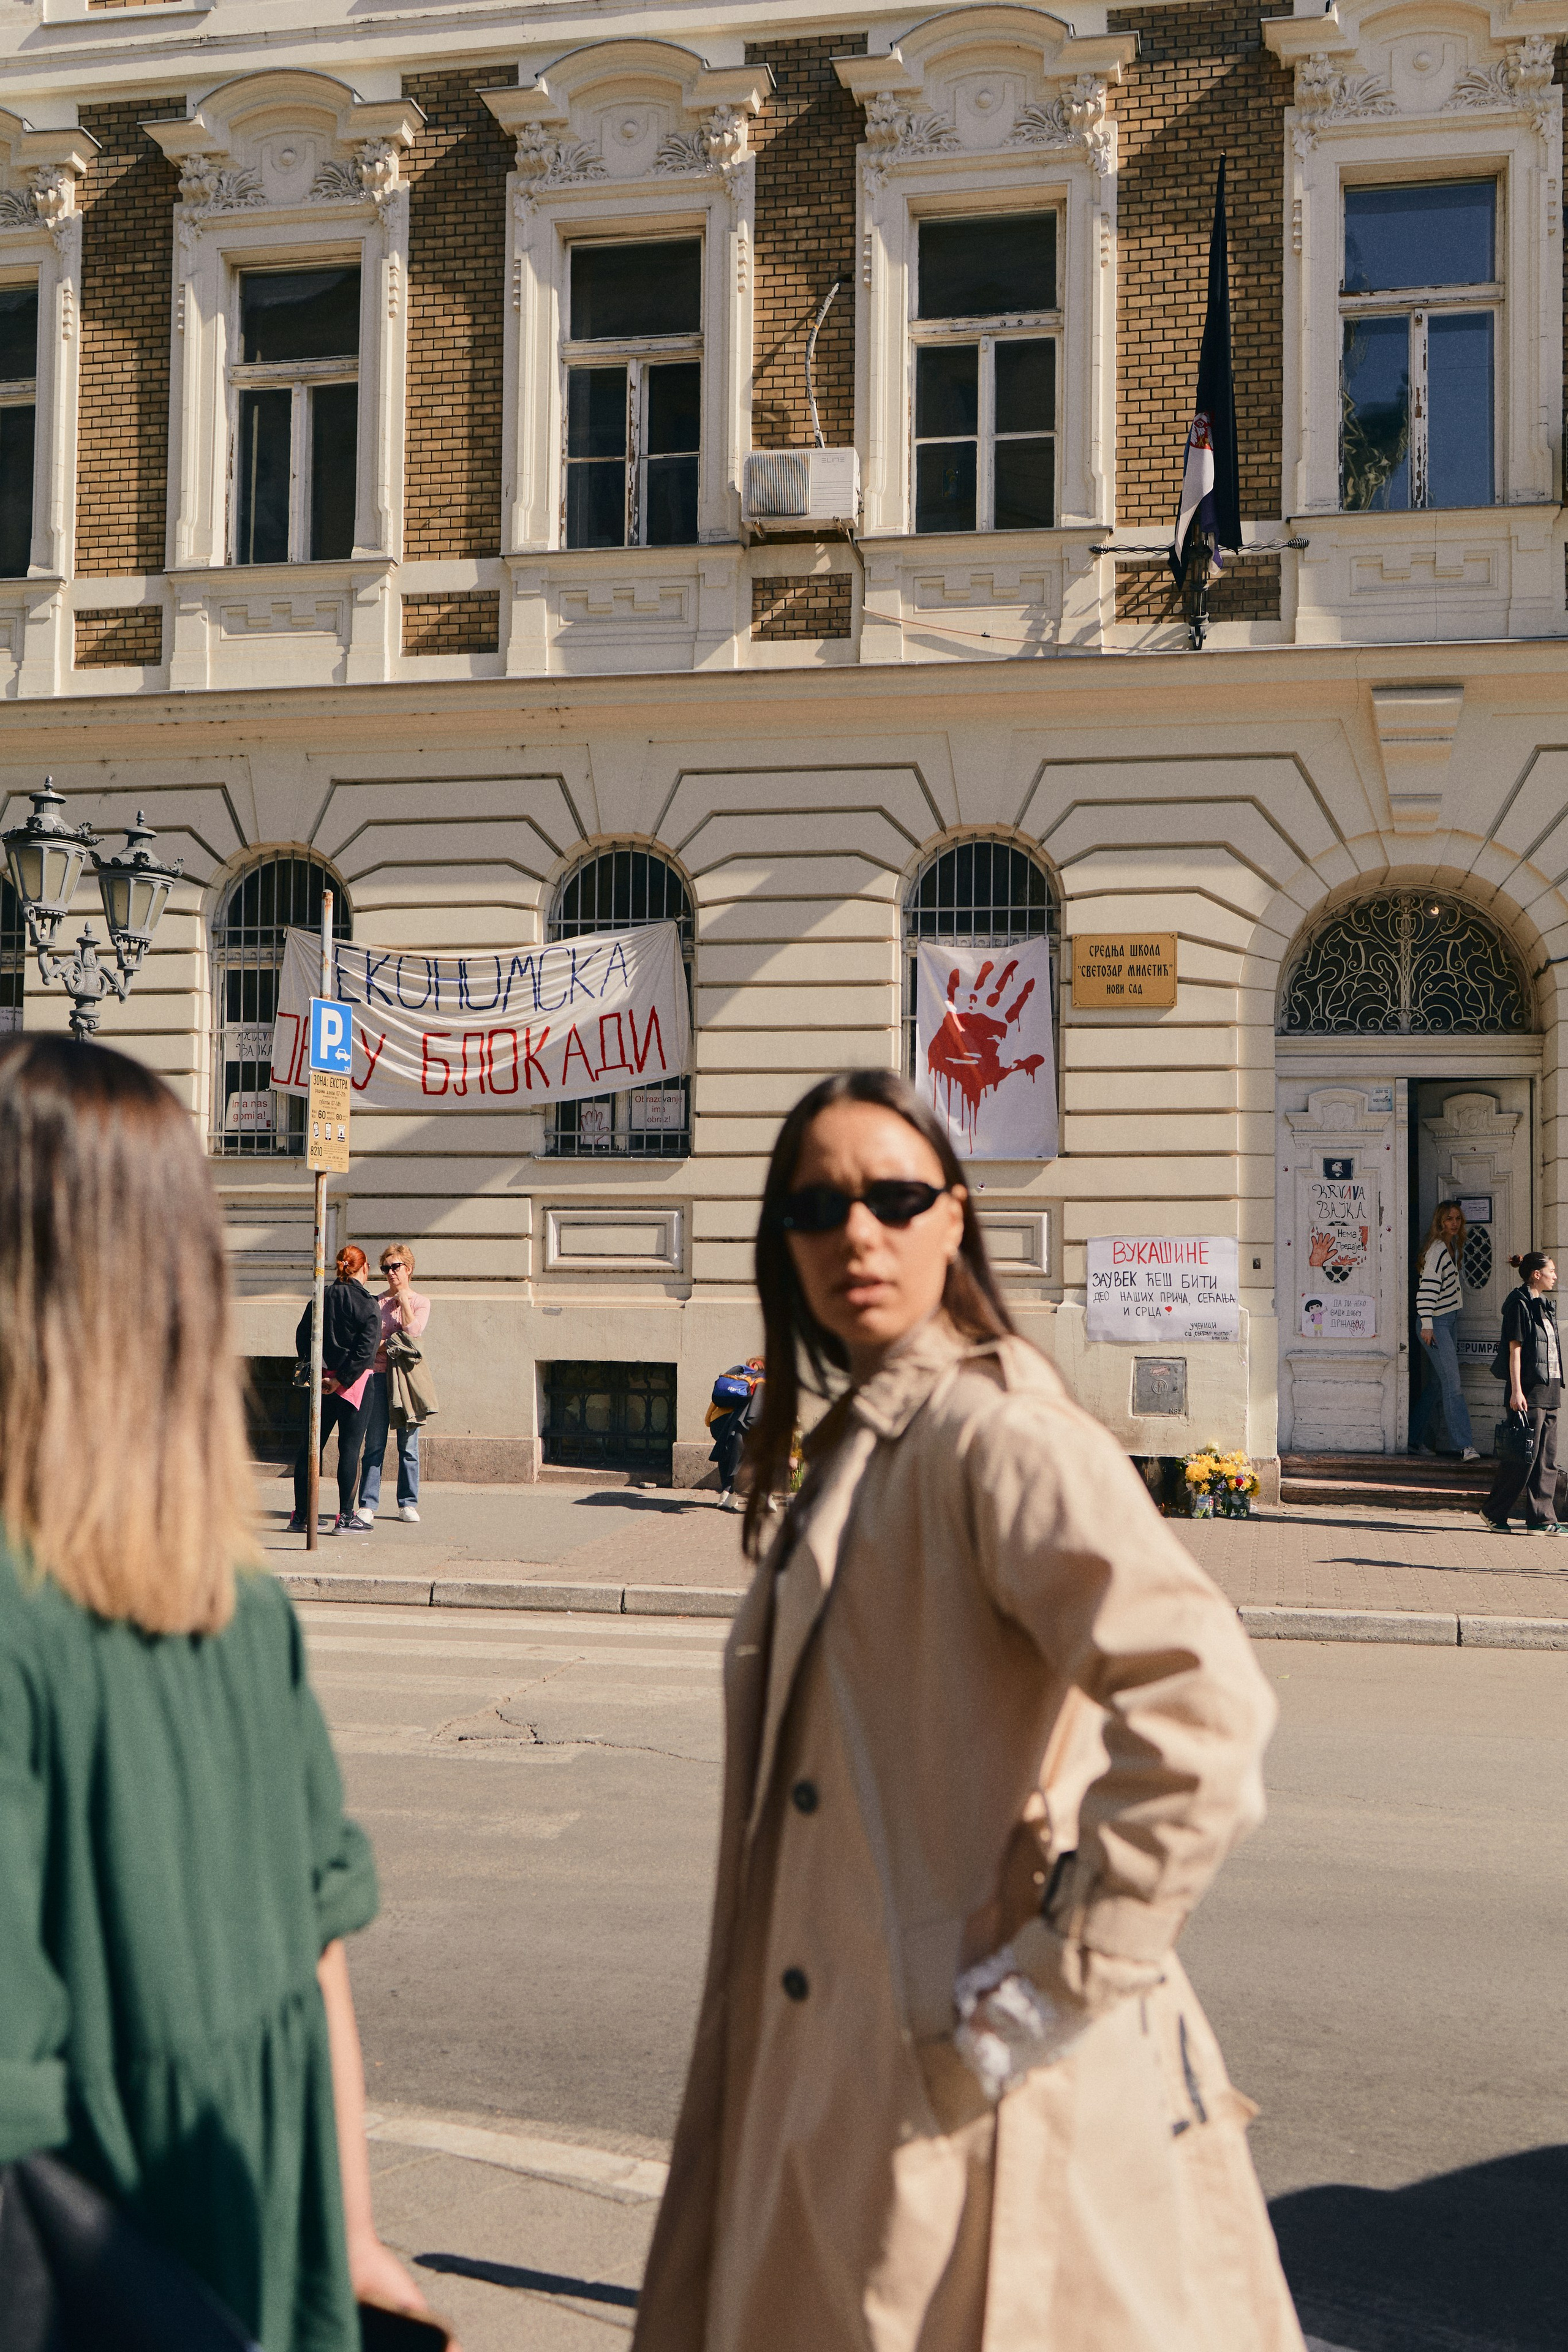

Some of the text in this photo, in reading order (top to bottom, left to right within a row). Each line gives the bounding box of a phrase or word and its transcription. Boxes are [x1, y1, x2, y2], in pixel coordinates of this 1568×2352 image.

[1089, 944, 1160, 958] СРЕДЊА ШКОЛА
[334, 942, 628, 1012] ЕКОНОМСКА
[1106, 984, 1143, 995] НОВИ САД
[320, 1008, 343, 1060] P
[352, 1028, 386, 1090] У
[421, 1005, 666, 1096] БЛОКАДИ
[313, 1074, 348, 1090] ЗОНА: ЕКСТРА
[233, 1111, 266, 1122] gomia!
[318, 1110, 326, 1119] 60
[310, 1146, 323, 1156] 8210
[1312, 1184, 1366, 1200] KRVAVA
[1316, 1200, 1366, 1219] BAJKA
[1338, 1229, 1357, 1238] Нема
[1113, 1241, 1209, 1265] ВУКАШИНЕ
[1336, 1242, 1364, 1254] Предаје!
[1092, 1271, 1218, 1289] ЗАУВЕК ЋЕШ БИТИ
[1093, 1291, 1237, 1306] ДЕО НАШИХ ПРИЧА, СЕЋАЊА
[1333, 1299, 1342, 1308] ДА
[1123, 1306, 1130, 1316] И
[1189, 1322, 1217, 1331] УЧЕНИЦИ
